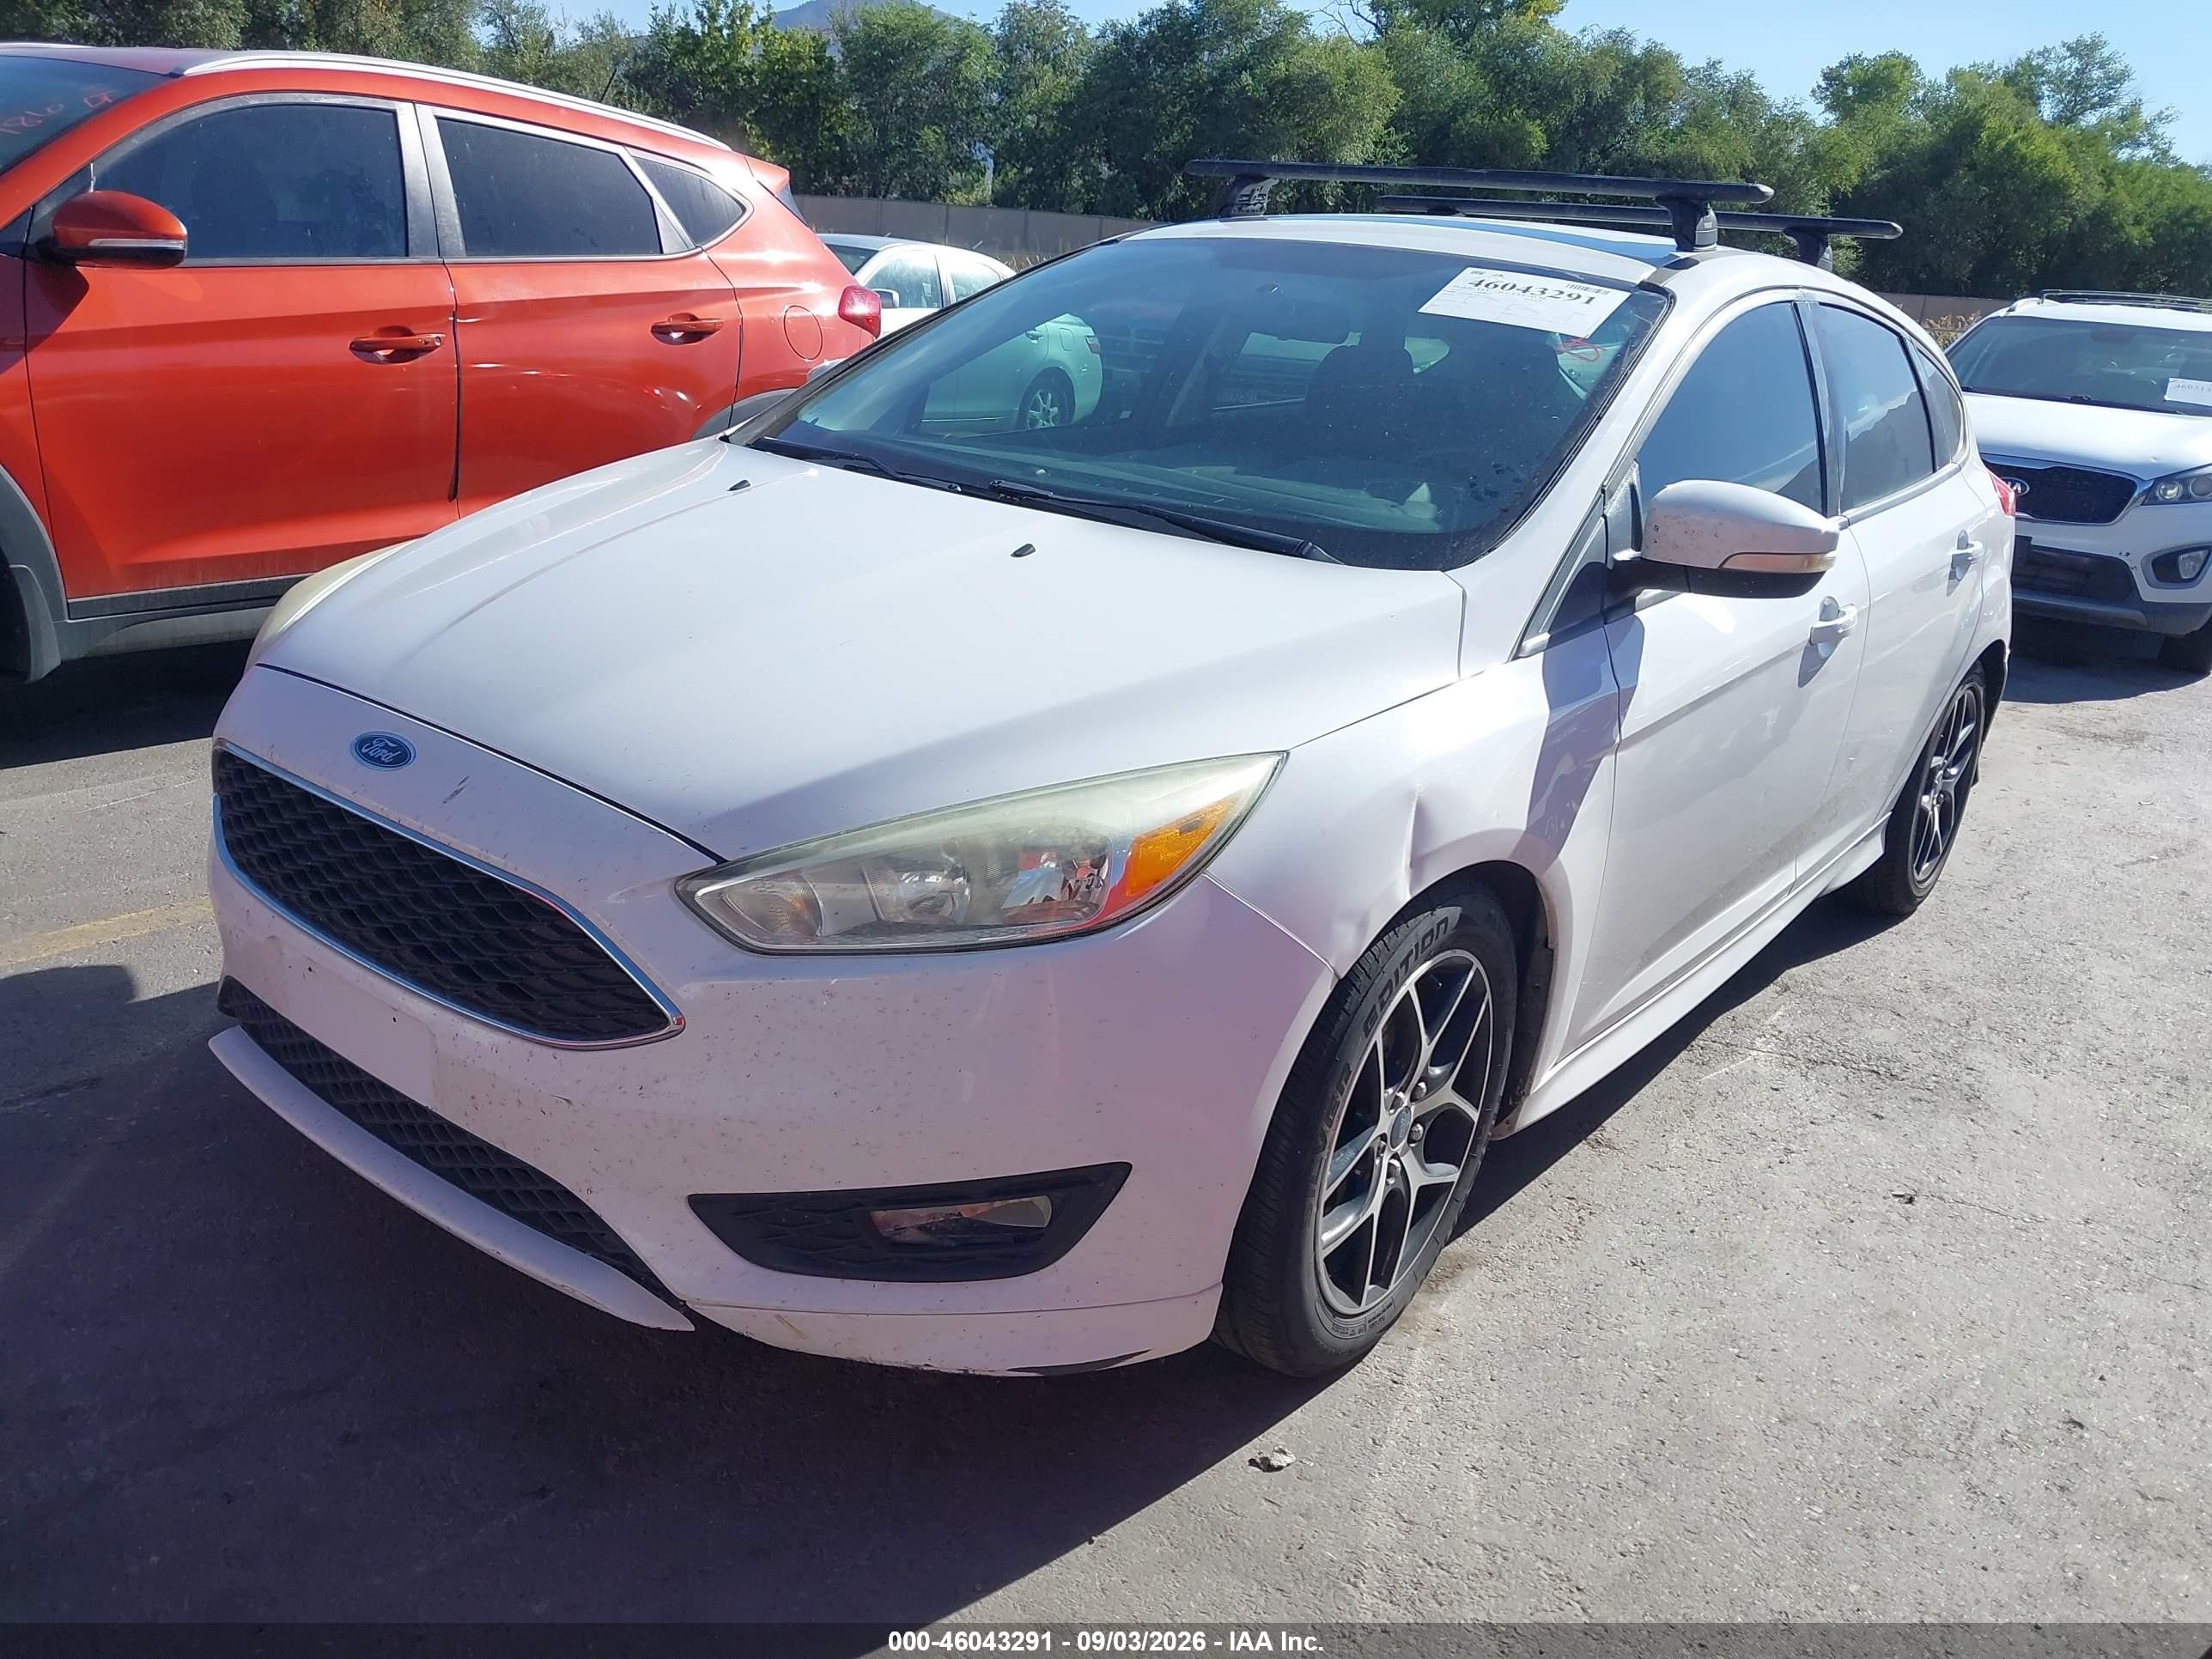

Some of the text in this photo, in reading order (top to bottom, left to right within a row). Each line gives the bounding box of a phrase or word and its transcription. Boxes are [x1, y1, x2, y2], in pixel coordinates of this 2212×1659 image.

[1468, 277, 1597, 306] 46043291
[361, 737, 402, 763] Ford
[1363, 915, 1449, 1040] EDITION
